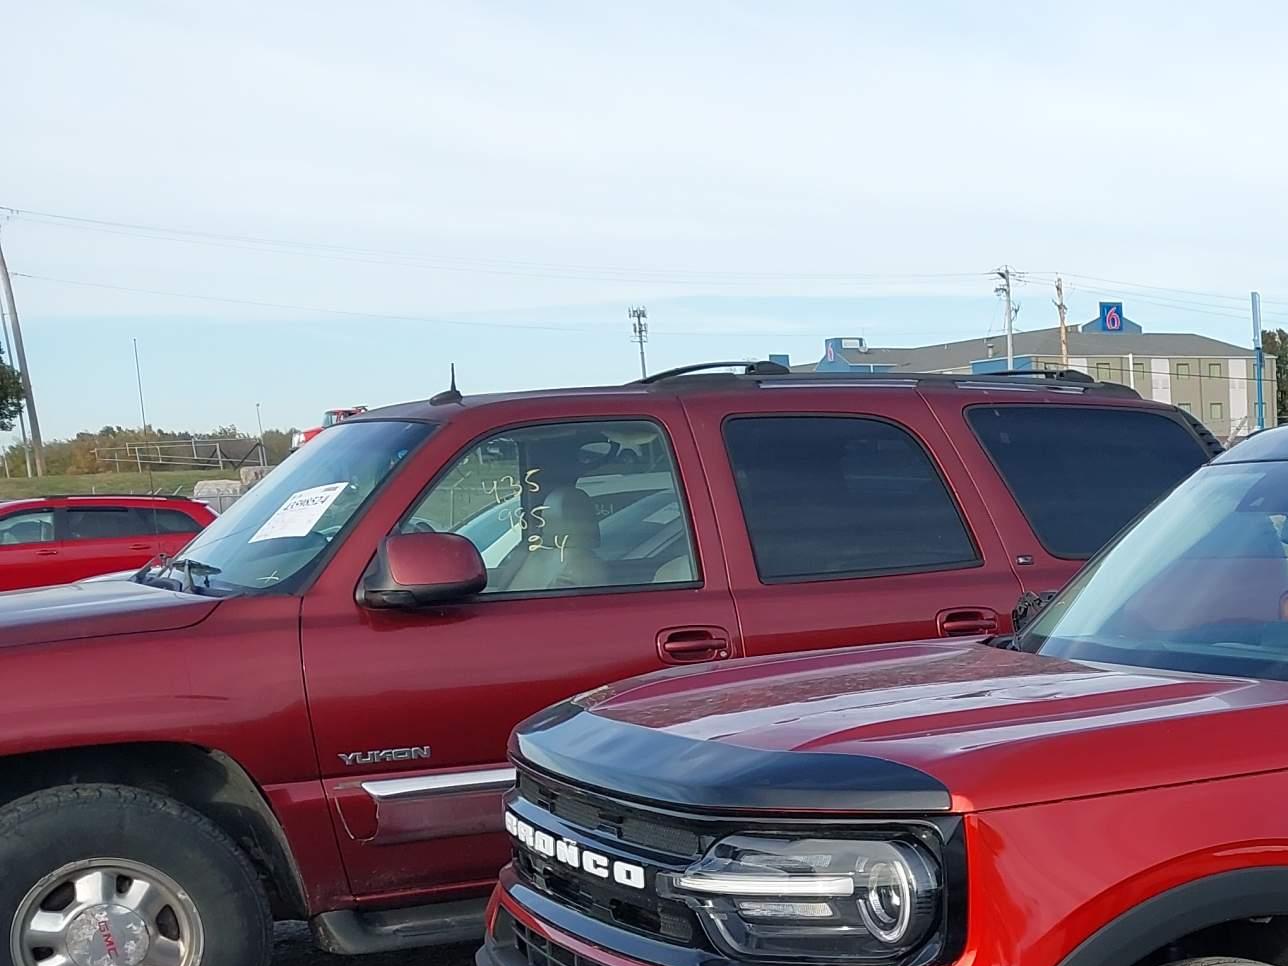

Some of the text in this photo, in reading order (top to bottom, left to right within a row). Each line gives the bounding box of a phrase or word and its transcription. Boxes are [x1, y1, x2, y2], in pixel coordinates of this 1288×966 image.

[1106, 306, 1120, 330] 6
[481, 468, 542, 504] 435
[498, 505, 550, 530] 985
[527, 534, 569, 562] 24
[337, 745, 431, 766] YUKON
[505, 811, 645, 889] BRONCO
[96, 919, 118, 959] GMC
